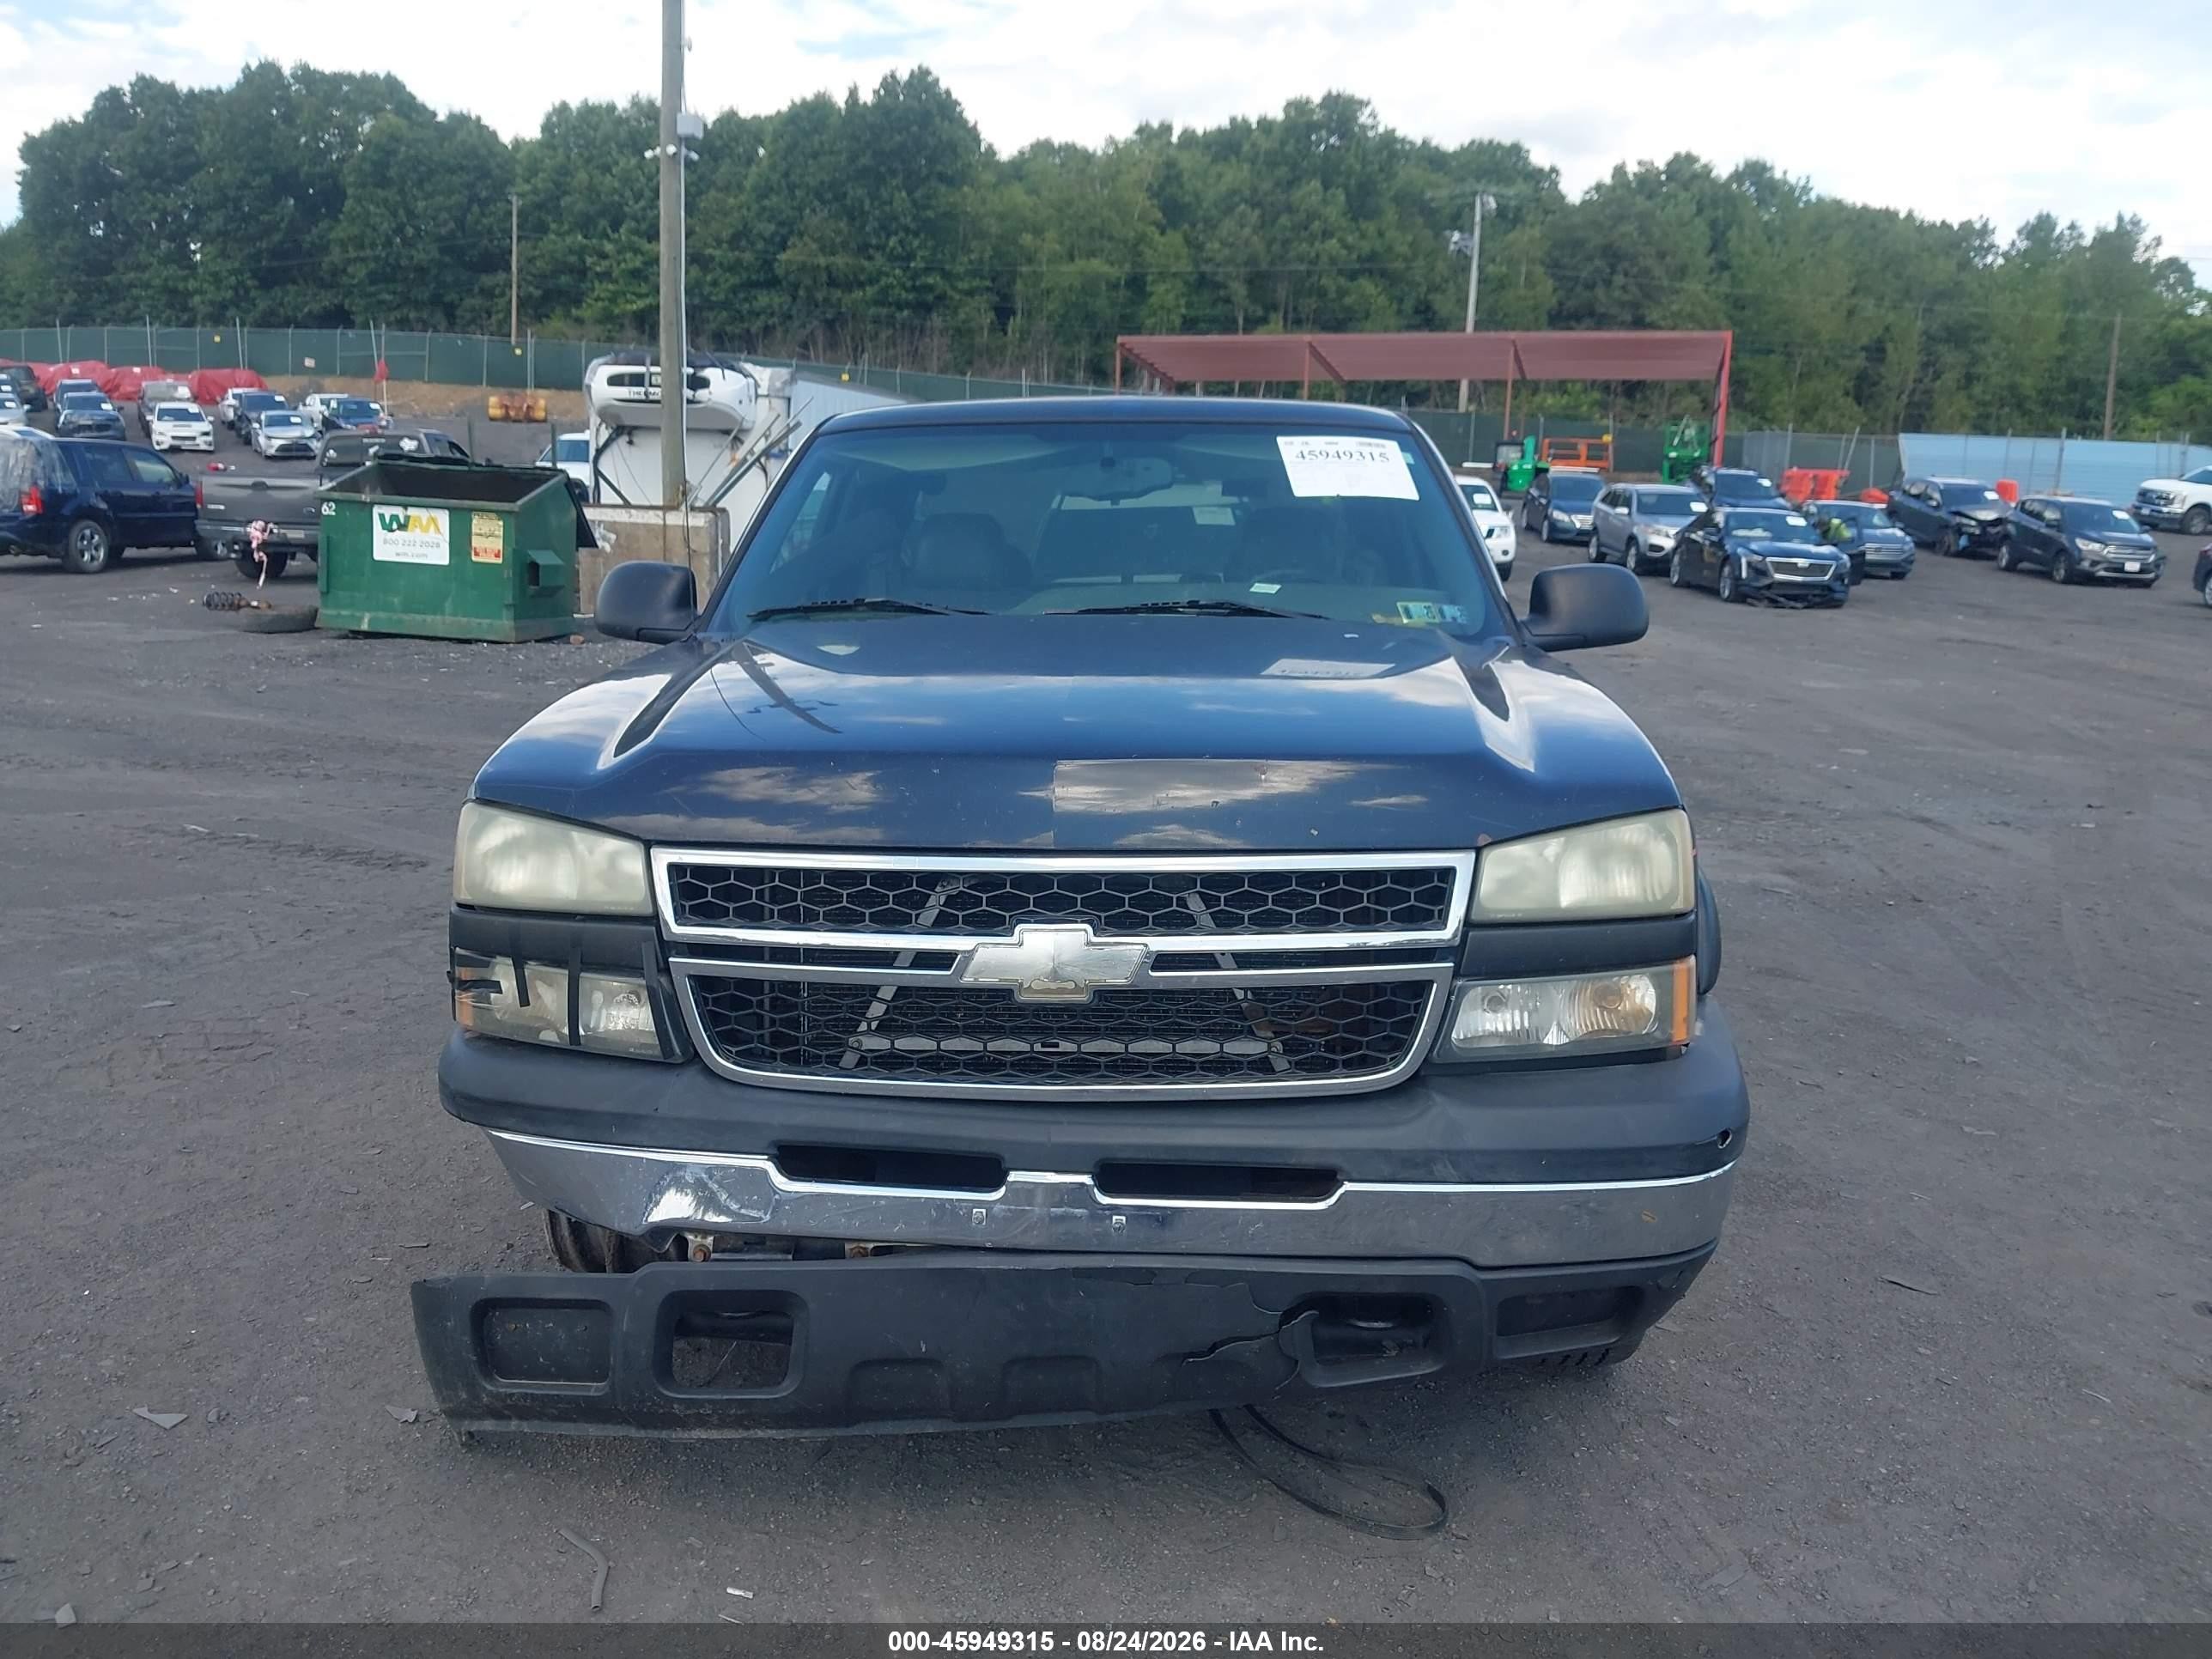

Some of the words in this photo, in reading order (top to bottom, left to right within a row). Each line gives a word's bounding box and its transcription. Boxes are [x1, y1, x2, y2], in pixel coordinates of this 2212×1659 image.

[1295, 449, 1390, 463] 45949315
[320, 501, 337, 516] 62
[377, 513, 441, 535] WM
